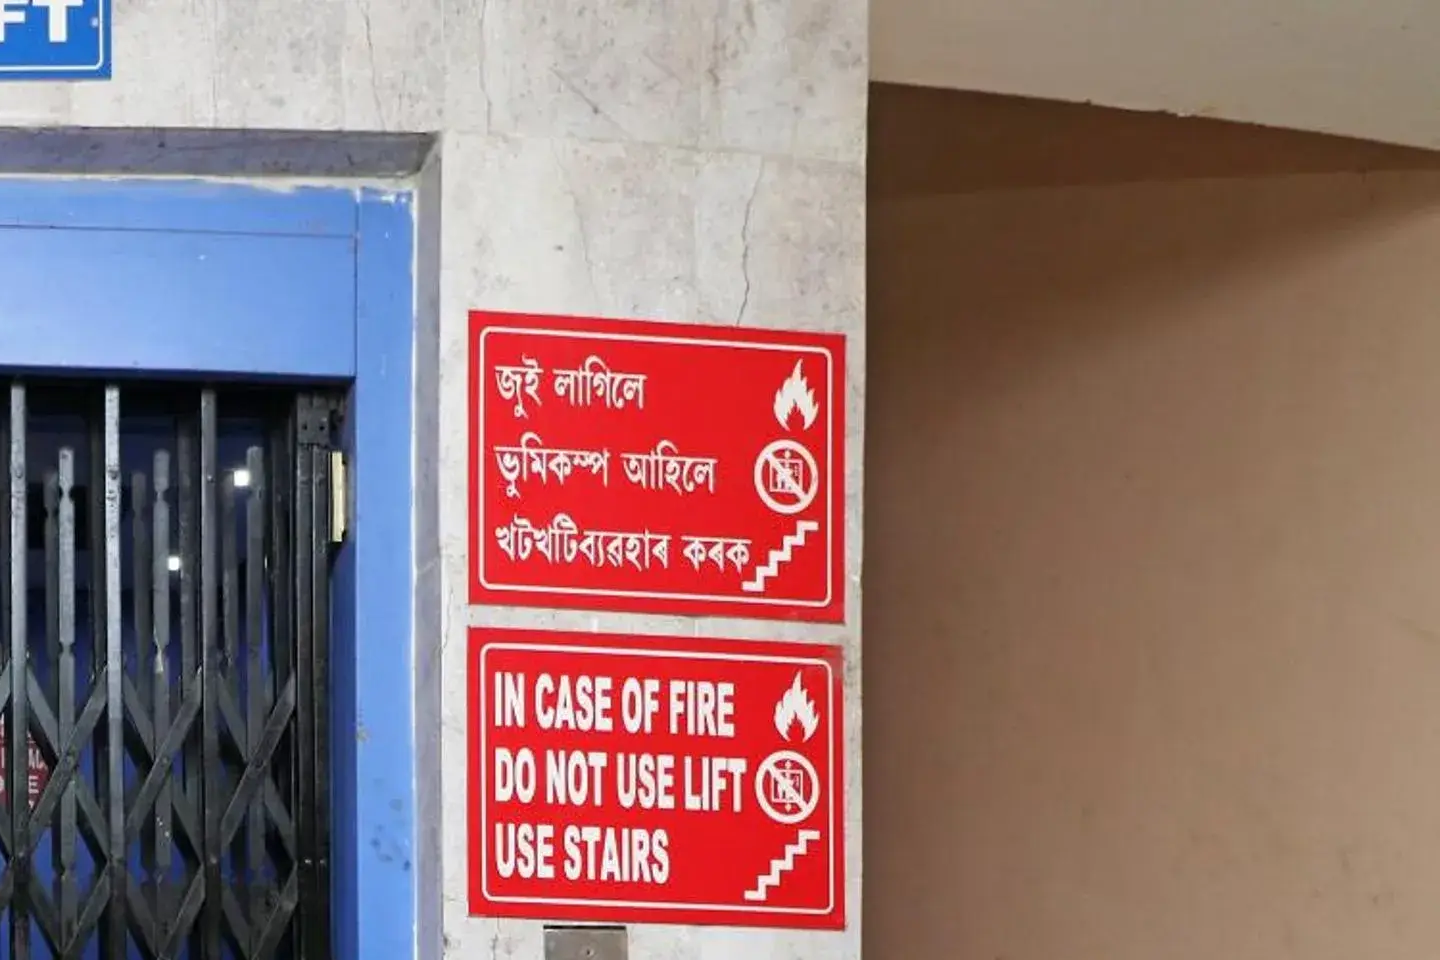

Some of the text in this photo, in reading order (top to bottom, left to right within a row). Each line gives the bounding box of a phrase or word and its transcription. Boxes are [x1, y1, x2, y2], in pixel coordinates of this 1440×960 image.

[494, 354, 647, 419] জুই লাগিলে
[621, 439, 718, 495] আহিলে
[681, 535, 753, 574] কৰক
[494, 671, 735, 738] IN CASE OF FIRE
[494, 747, 747, 813] DO NOT USE LIFT
[495, 822, 670, 884] USE STAIRS
